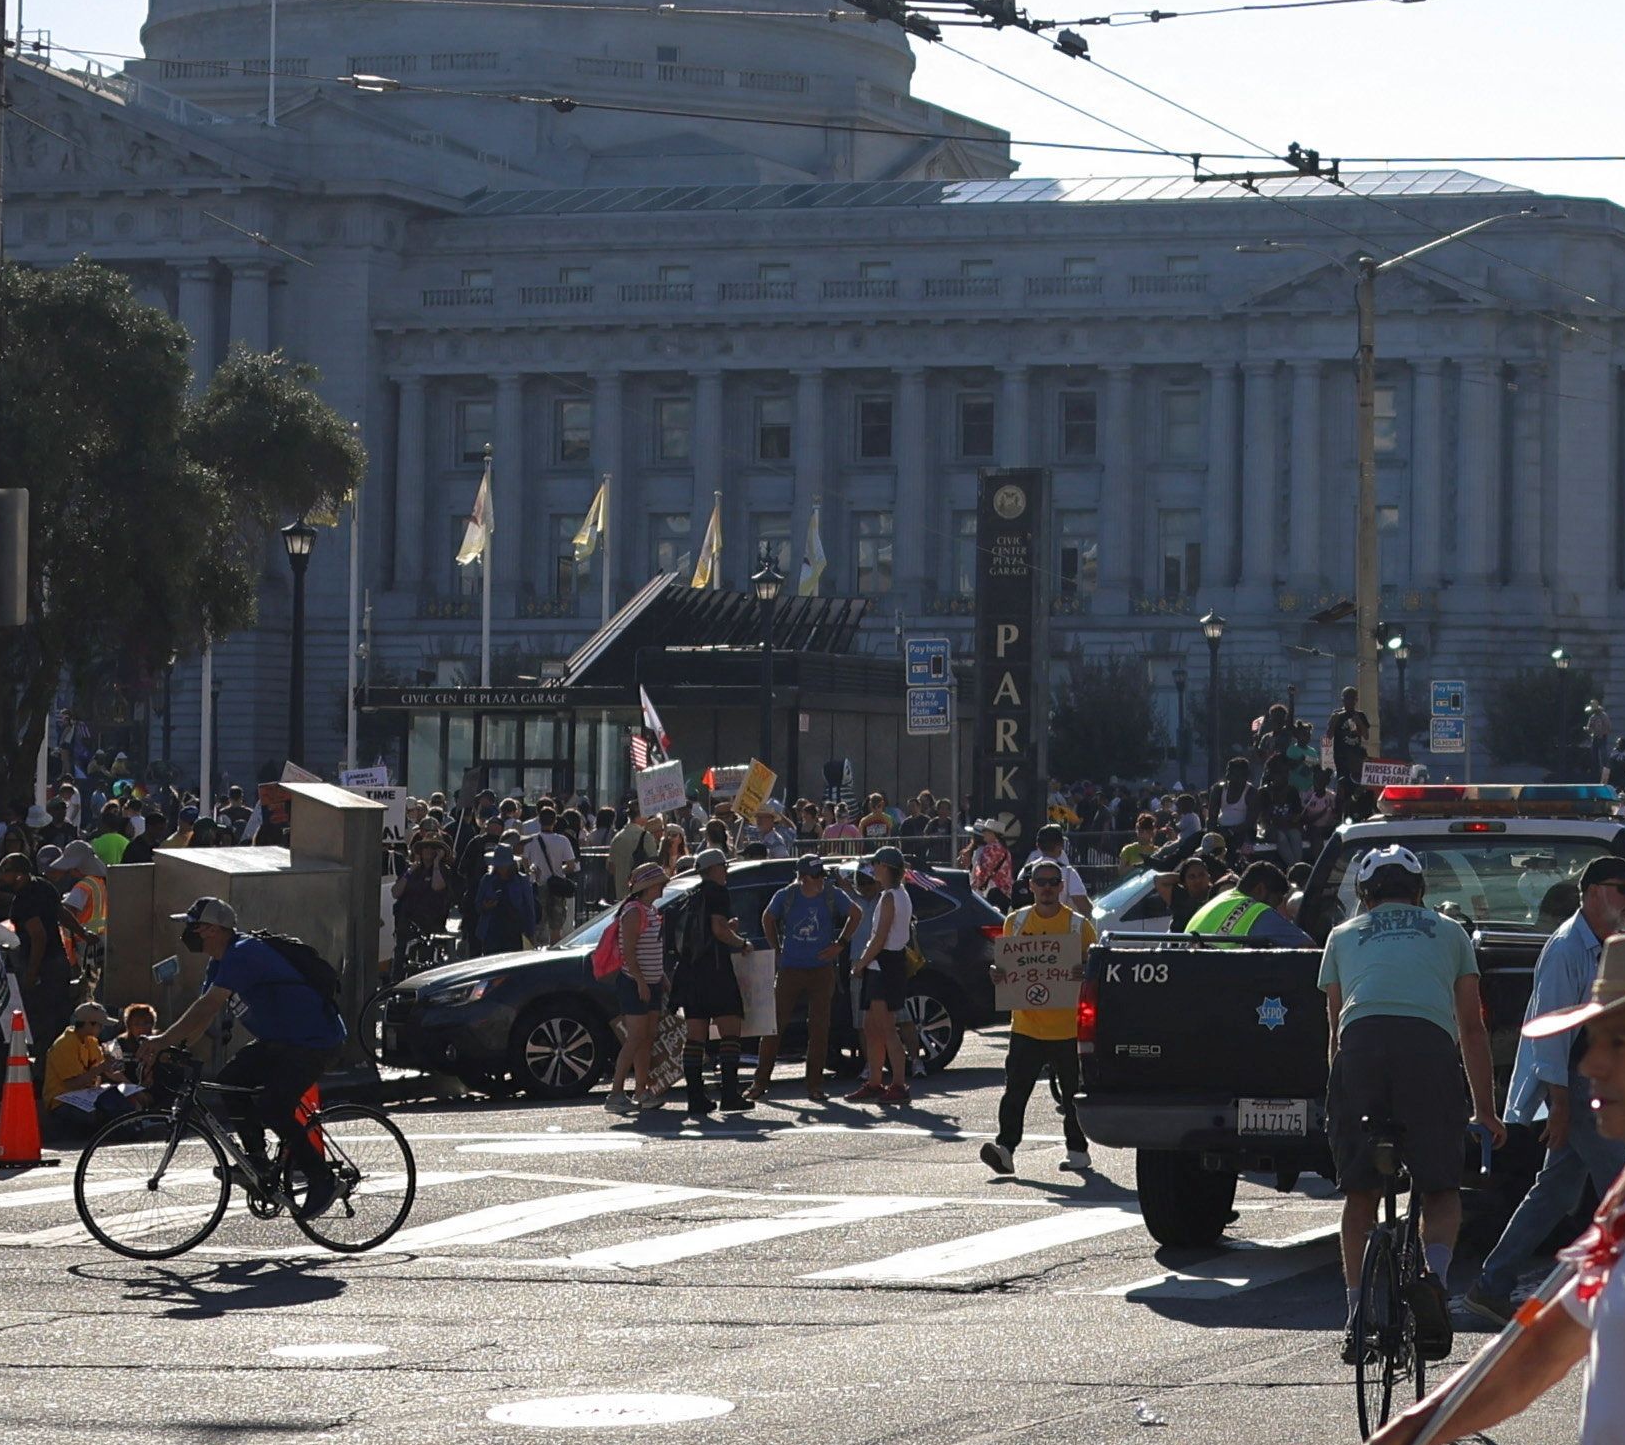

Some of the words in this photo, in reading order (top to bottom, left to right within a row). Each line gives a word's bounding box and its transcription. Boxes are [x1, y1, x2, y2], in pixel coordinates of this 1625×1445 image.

[996, 536, 1021, 545] CIVIC
[991, 546, 1027, 555] CENTER
[992, 556, 1024, 565] PLAZA
[989, 567, 1028, 576] GARAGE
[909, 644, 926, 654] Pay
[927, 644, 945, 653] here
[401, 694, 431, 704] CIVIC
[480, 693, 516, 704] PLAZA
[521, 693, 567, 704] GARAGE
[910, 691, 924, 700] Pay
[992, 624, 1022, 800] PARK
[1365, 764, 1392, 775] NURSES
[1392, 765, 1411, 776] CARE
[366, 790, 396, 800] TIME
[1003, 940, 1061, 955] ANTIFA
[1003, 967, 1081, 985] 12-8-194
[1106, 963, 1122, 983] K
[1131, 963, 1169, 983] 103
[1261, 1007, 1282, 1020] SFPD
[1245, 1113, 1302, 1132] 1117175
